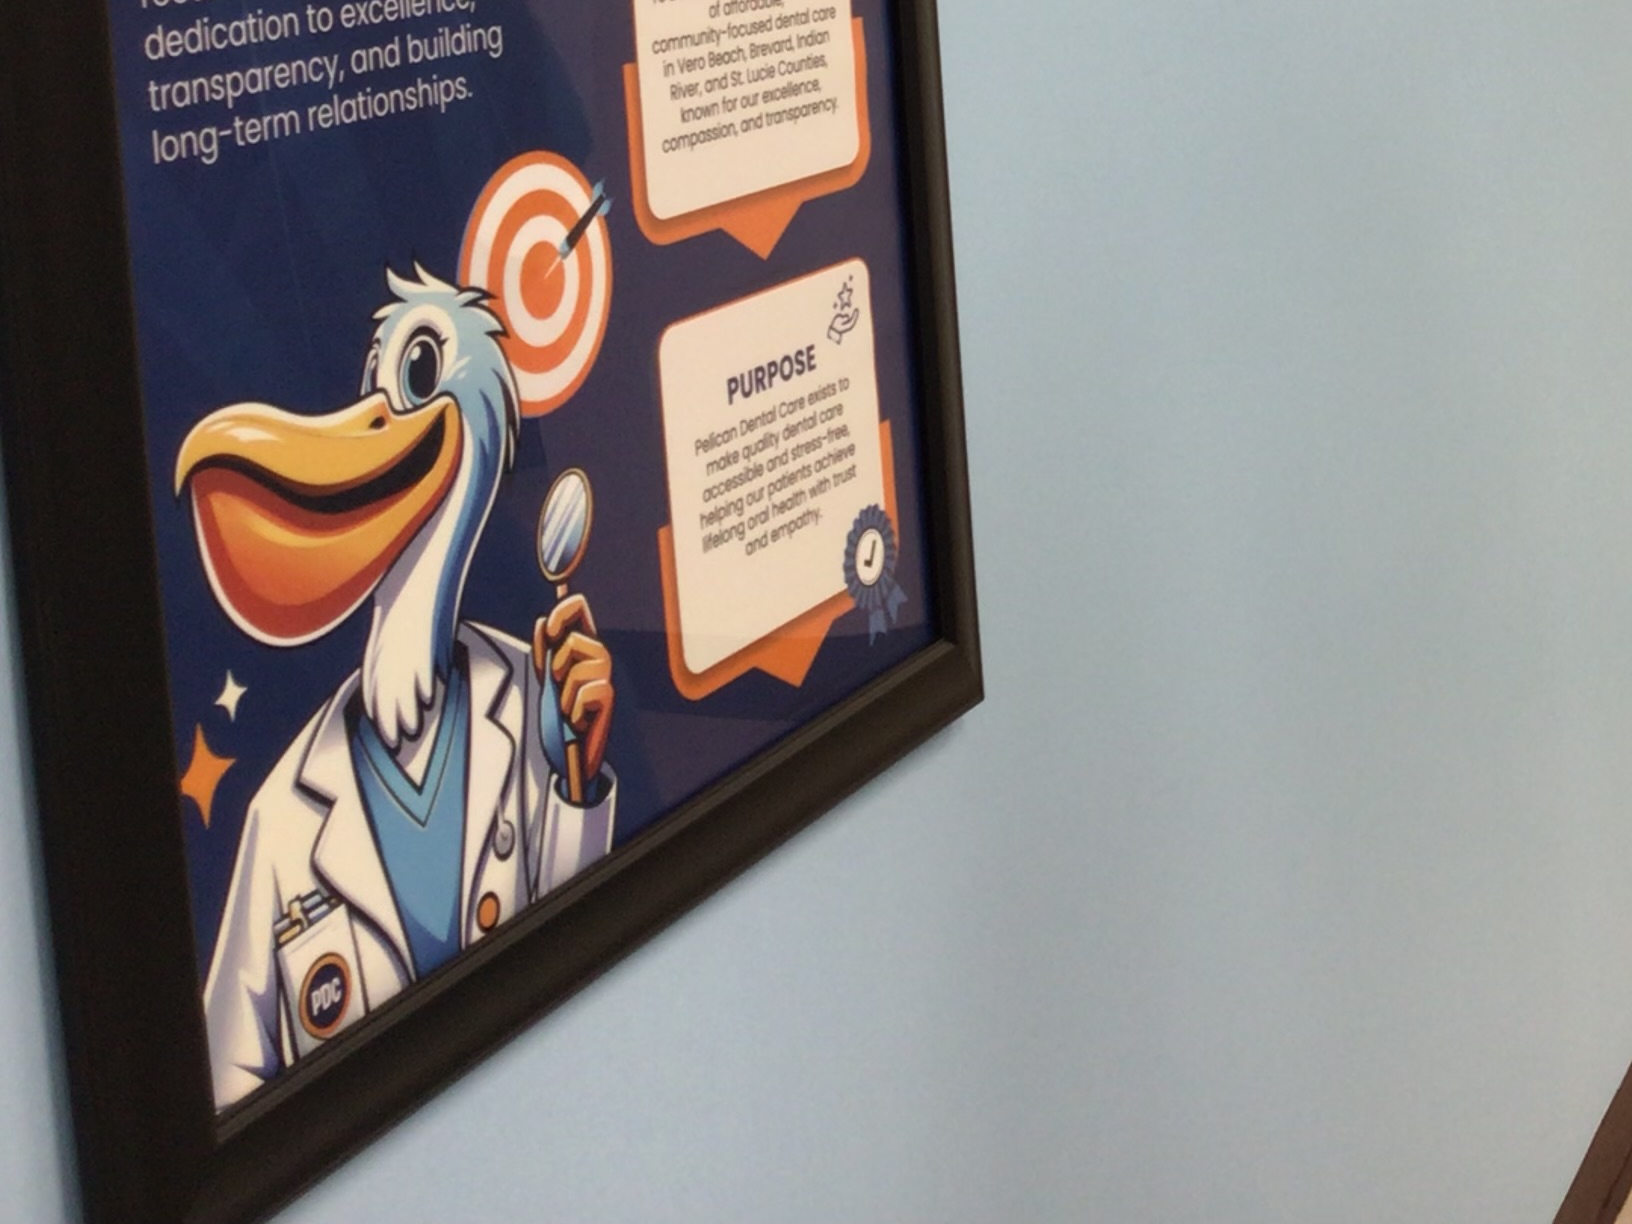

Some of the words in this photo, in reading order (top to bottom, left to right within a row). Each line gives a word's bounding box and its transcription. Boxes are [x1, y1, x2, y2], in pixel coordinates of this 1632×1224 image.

[145, 10, 299, 60] dedication
[307, 5, 332, 35] to
[652, 14, 772, 54] community-focused
[775, 8, 809, 30] dental
[813, 5, 836, 22] care
[709, 0, 720, 19] of
[149, 53, 344, 111] transparency,
[350, 38, 400, 74] and
[407, 23, 502, 64] building
[663, 60, 674, 77] in
[677, 56, 705, 75] Vero
[796, 29, 830, 49] Indian
[705, 74, 728, 93] and
[747, 63, 775, 83] Lucie
[152, 109, 299, 164] long-term
[308, 75, 473, 131] relationships.
[681, 99, 719, 124] known
[722, 95, 737, 113] for
[741, 92, 759, 109] our
[741, 113, 763, 133] and
[727, 344, 816, 405] PURPOSE
[695, 428, 737, 456] Pelican
[740, 406, 776, 436] Dental
[779, 395, 805, 418] Care
[808, 383, 836, 405] exists
[839, 377, 849, 393] to
[706, 449, 739, 476] make
[743, 431, 779, 461] quality
[782, 412, 817, 441] dental
[819, 403, 843, 425] care
[700, 497, 744, 529] helping
[747, 483, 764, 506] our
[768, 462, 812, 499] patients
[814, 443, 855, 474] achieve
[702, 461, 763, 503] accessible
[766, 450, 788, 472] and
[702, 520, 745, 554] lifelong
[748, 505, 769, 530] oral
[772, 489, 806, 518] health
[809, 478, 831, 499] with
[833, 463, 856, 488] trust
[746, 535, 768, 556] and
[311, 977, 341, 1016] PDC
